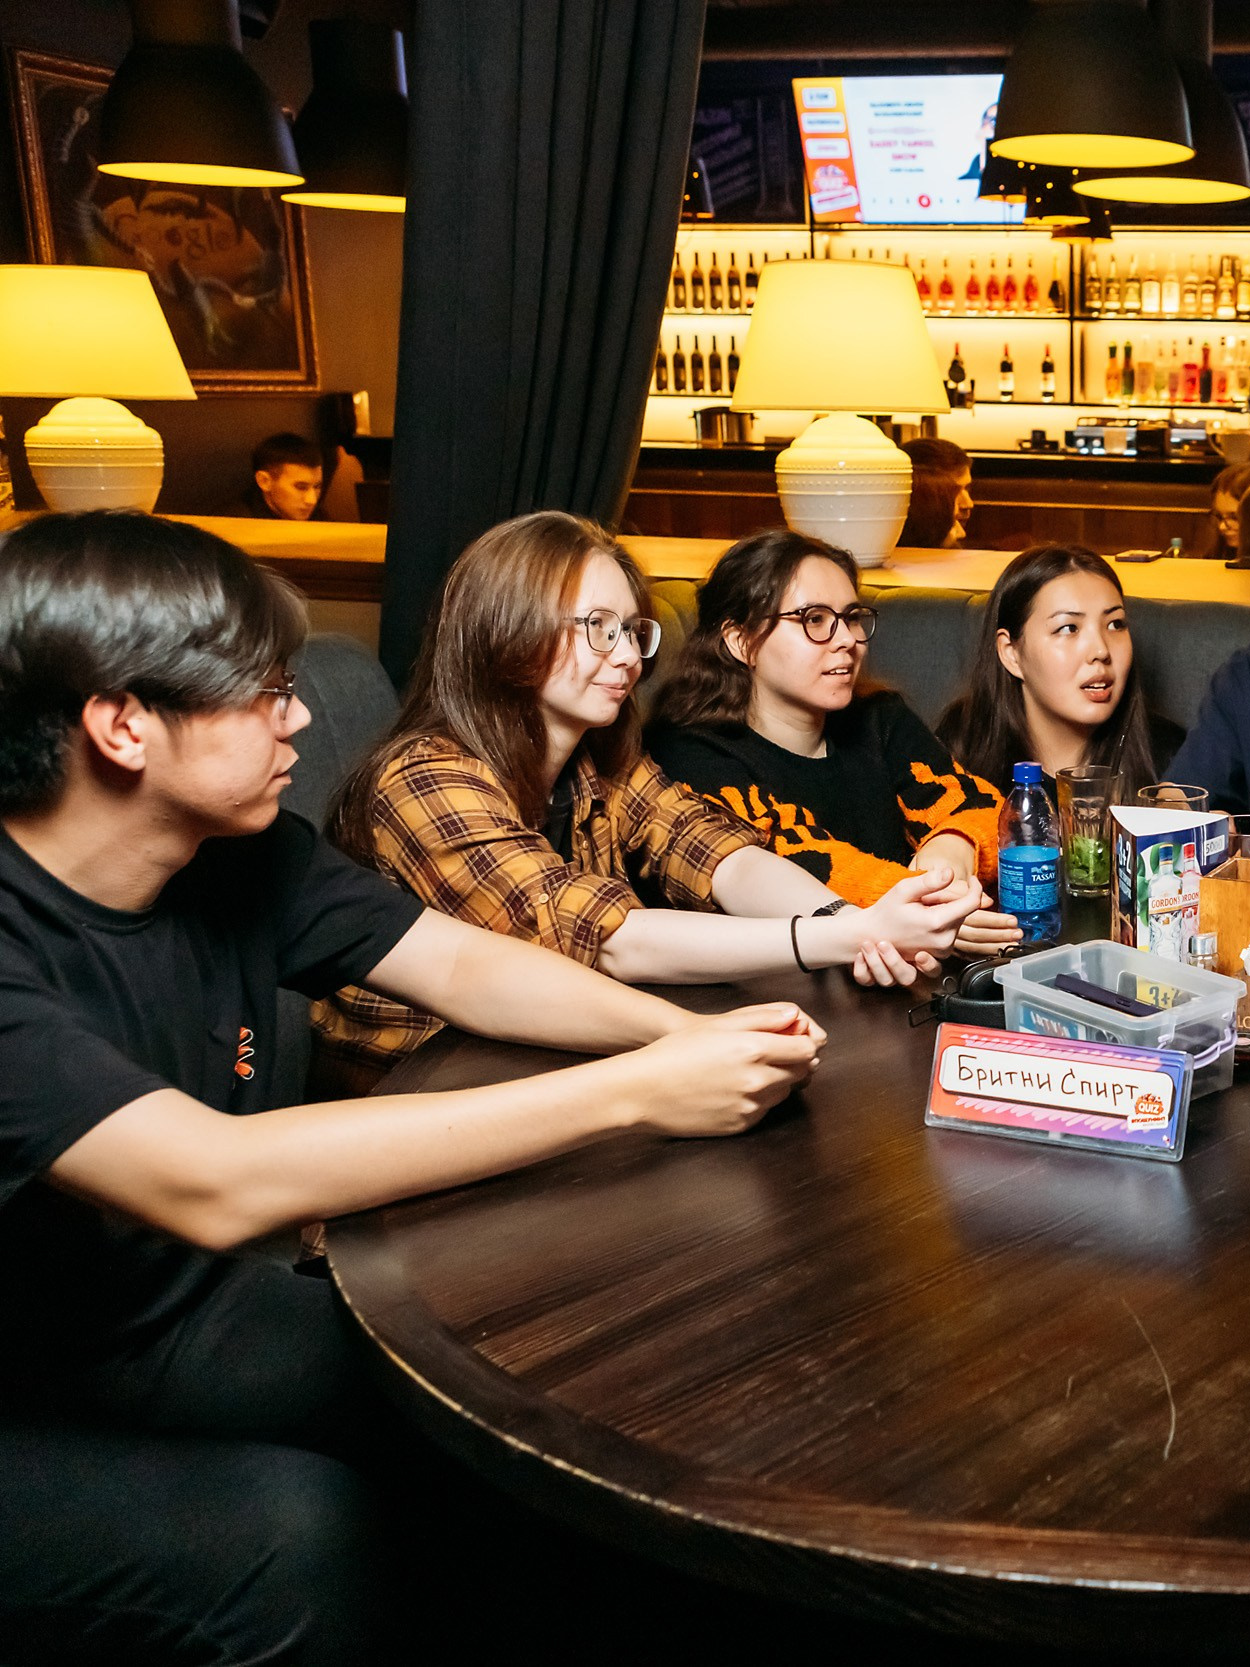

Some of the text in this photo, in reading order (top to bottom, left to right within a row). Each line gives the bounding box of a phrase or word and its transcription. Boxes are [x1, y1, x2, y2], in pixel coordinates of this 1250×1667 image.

[1031, 872, 1056, 882] TASSAY
[958, 1054, 1140, 1106] Бритни Спирт
[1138, 1102, 1160, 1114] QUIZ
